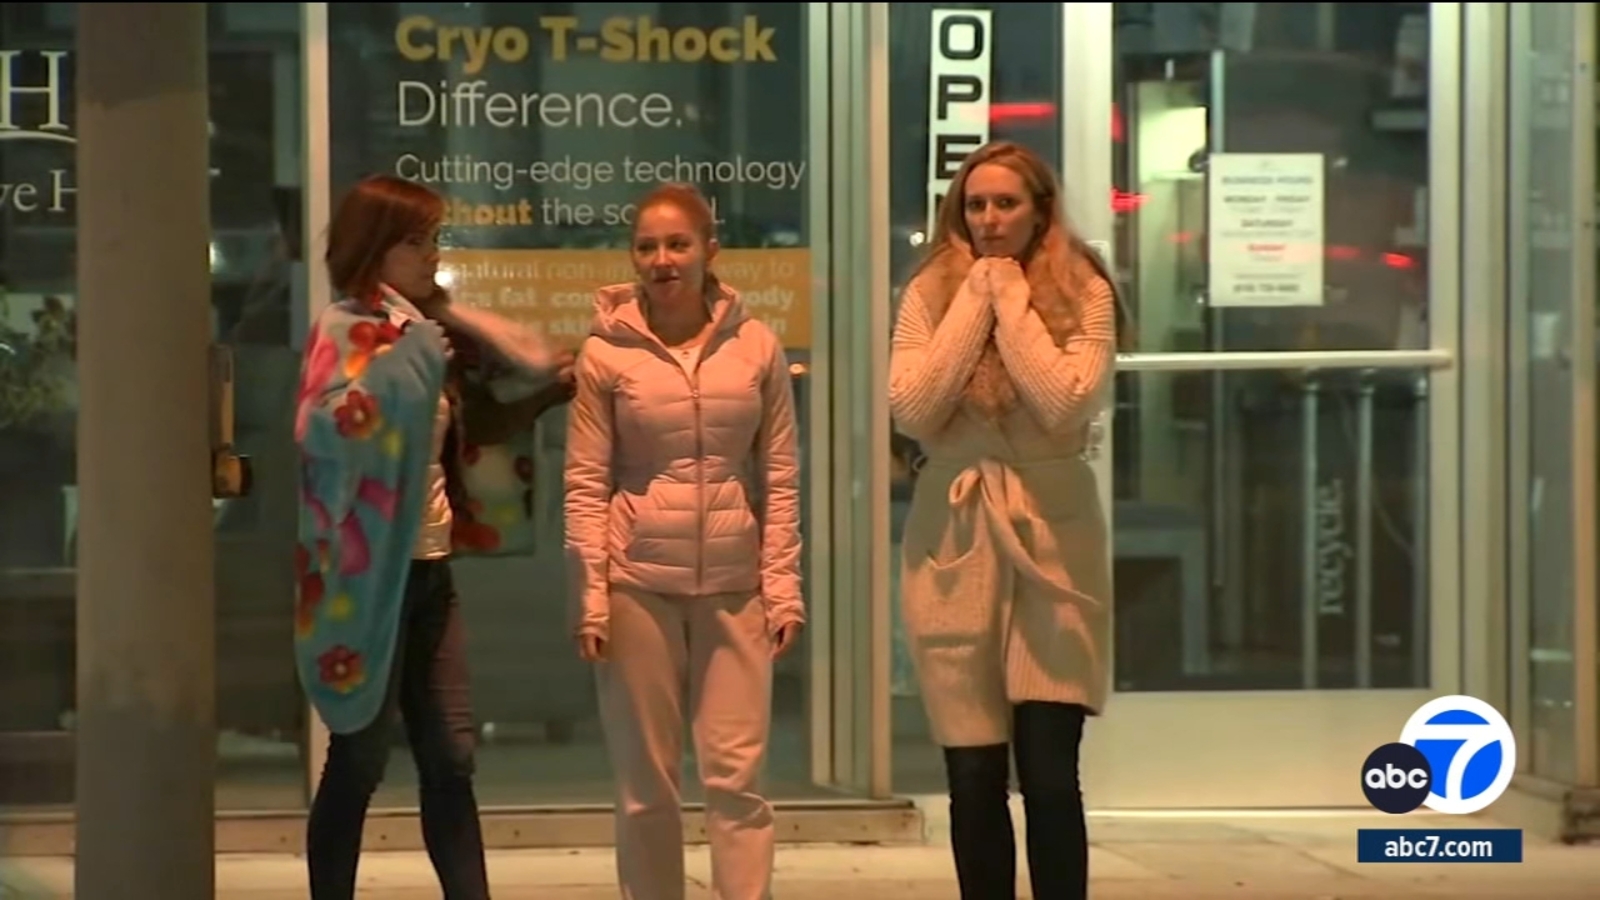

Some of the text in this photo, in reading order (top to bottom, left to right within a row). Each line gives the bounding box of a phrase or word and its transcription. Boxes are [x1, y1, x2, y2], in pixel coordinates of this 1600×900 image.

[395, 14, 777, 74] Cryo T-Shock
[398, 80, 683, 127] Difference.
[935, 15, 985, 222] OPE
[395, 154, 807, 190] Cutting-edge technology
[440, 198, 533, 225] thout
[541, 197, 595, 225] the
[744, 284, 796, 312] ody
